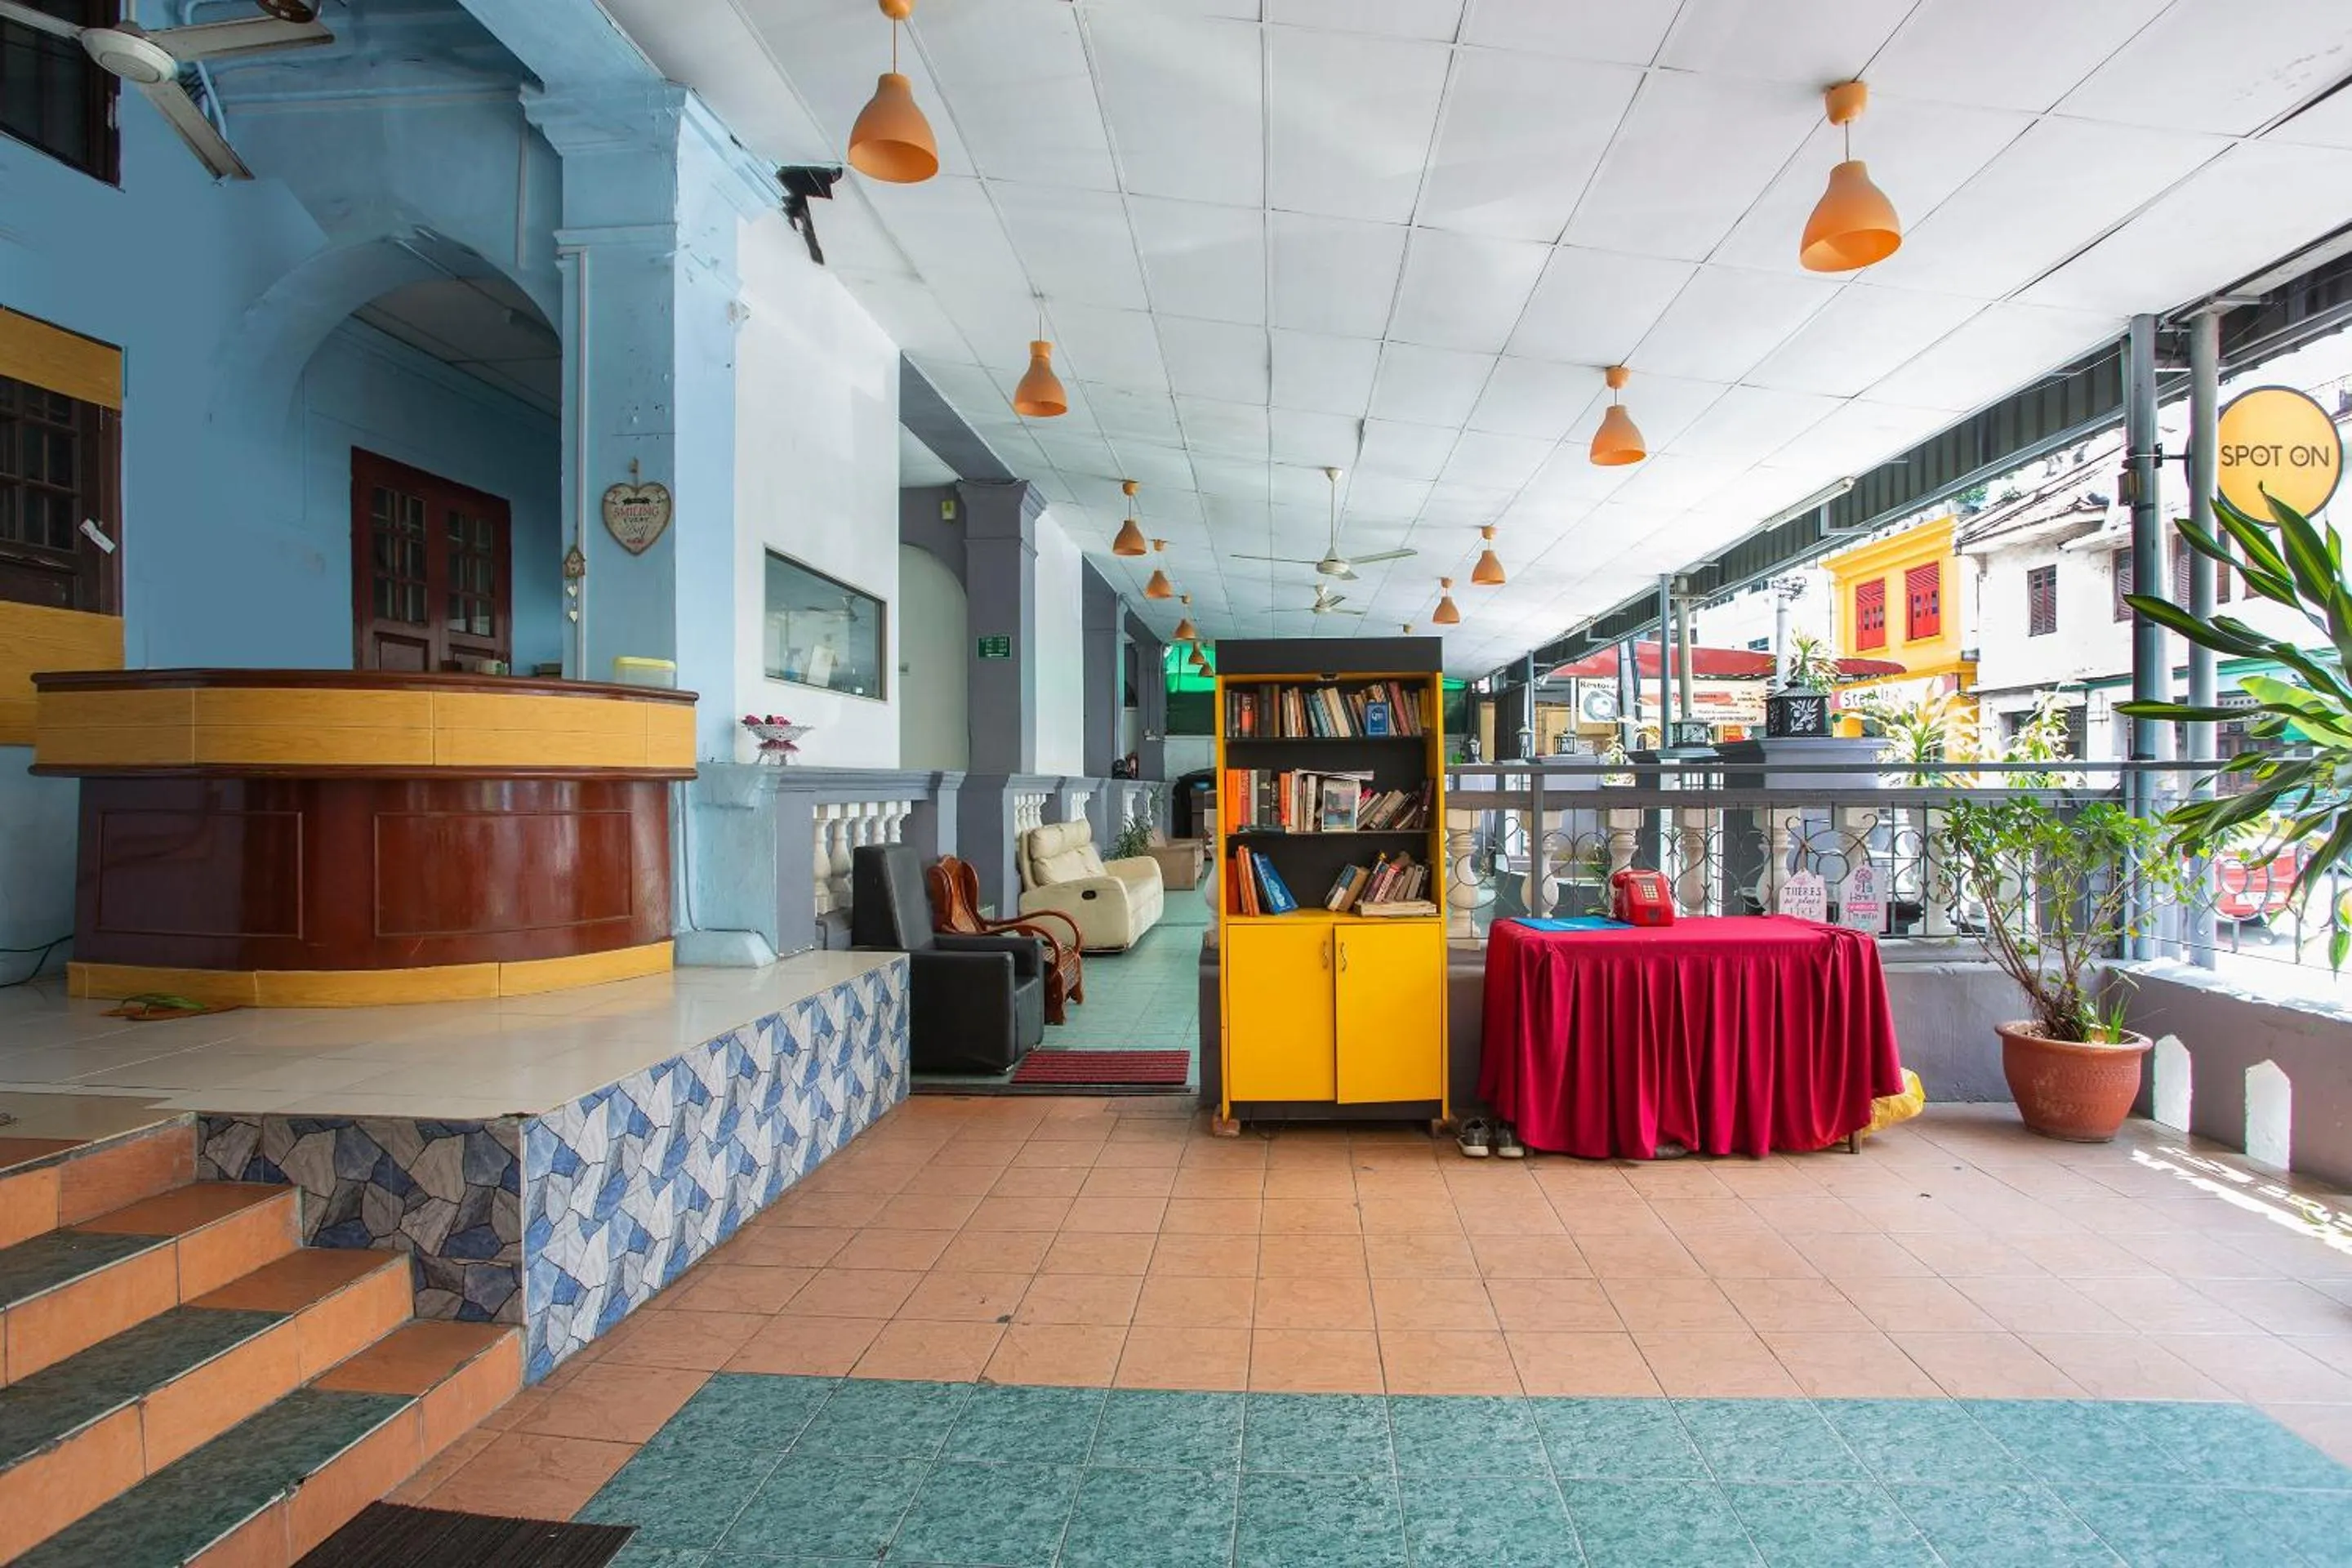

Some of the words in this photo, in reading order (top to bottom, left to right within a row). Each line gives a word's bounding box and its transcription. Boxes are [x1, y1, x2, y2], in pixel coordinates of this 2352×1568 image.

[2221, 445, 2283, 467] SPOT
[2290, 445, 2329, 467] ON
[614, 506, 659, 517] SMILING
